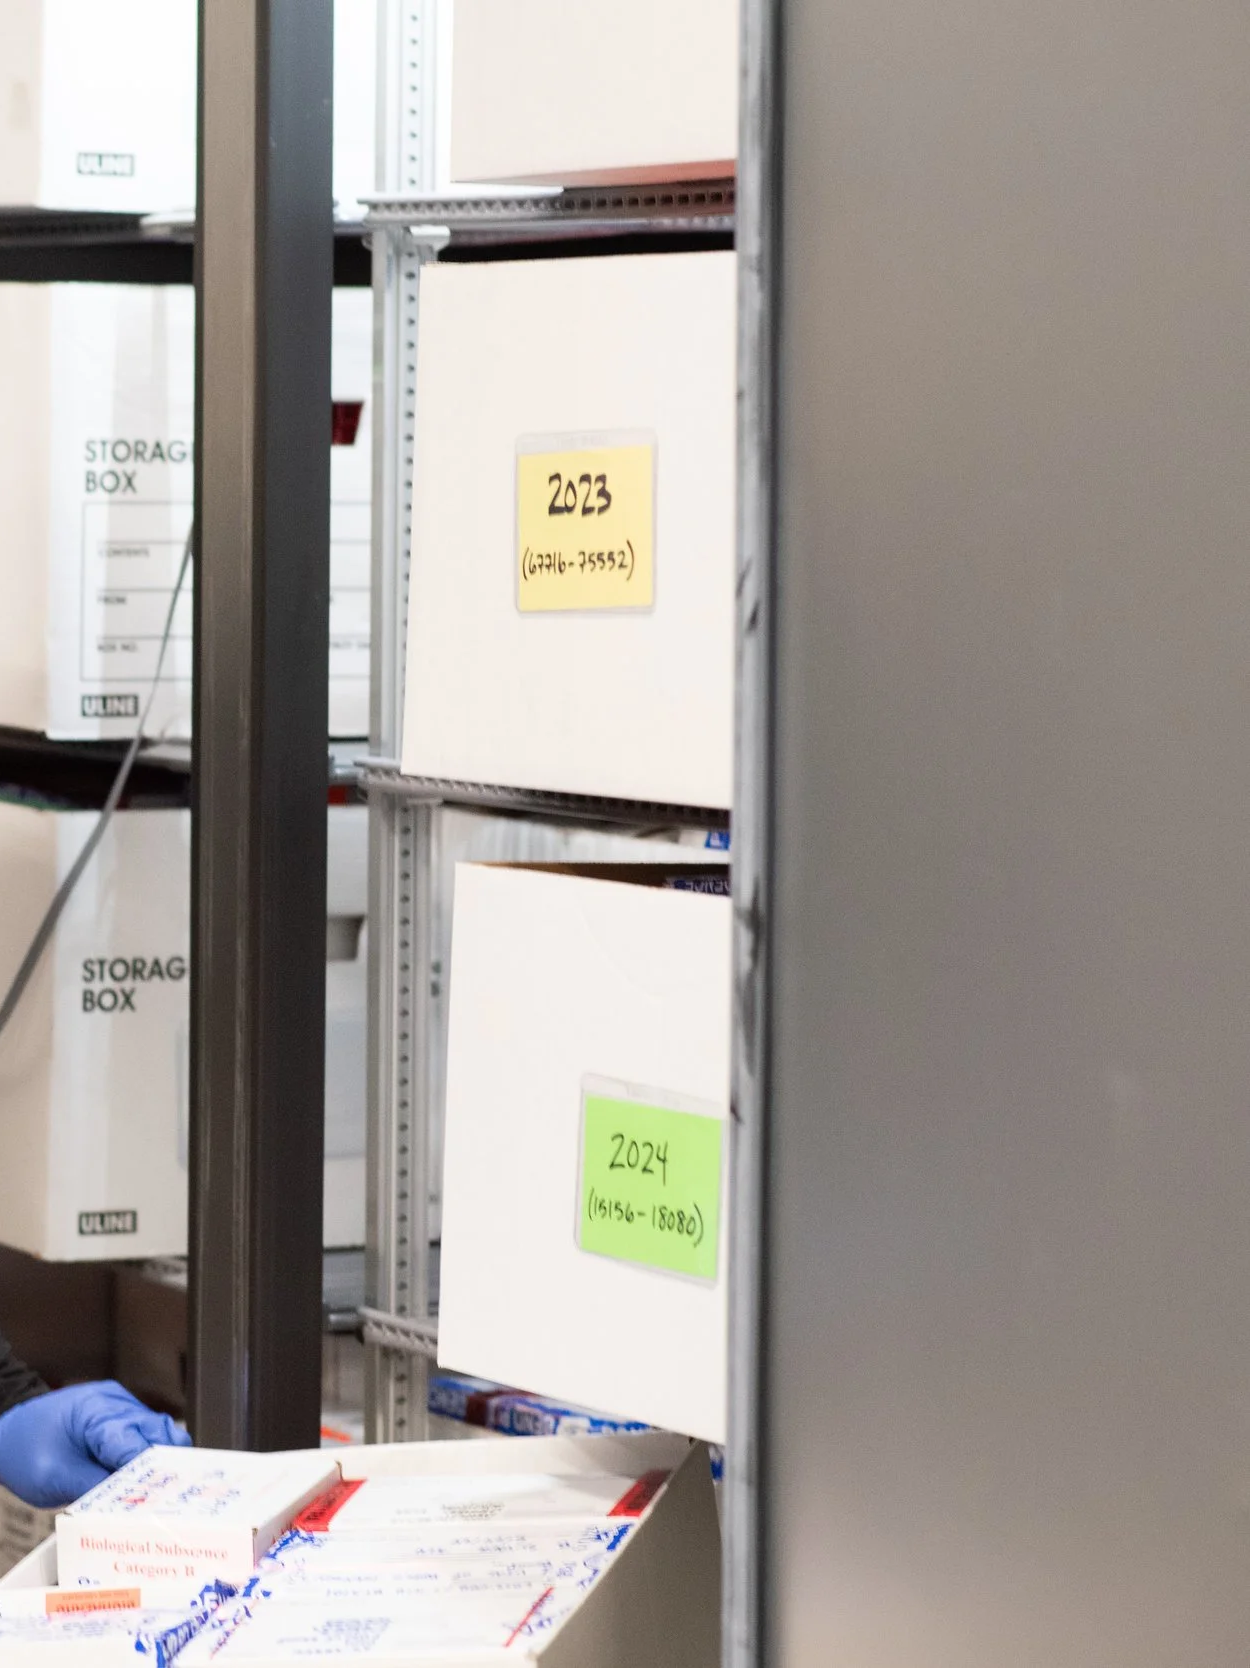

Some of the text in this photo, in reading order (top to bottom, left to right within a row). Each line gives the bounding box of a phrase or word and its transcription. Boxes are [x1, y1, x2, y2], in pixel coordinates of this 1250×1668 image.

[77, 152, 134, 177] ULINE
[85, 438, 188, 463] STORAG
[85, 468, 138, 494] BOX
[548, 472, 612, 517] 2023
[81, 694, 138, 717] ULINE
[82, 956, 186, 982] STORAG
[82, 987, 136, 1012] BOX
[609, 1132, 669, 1186] 2024
[78, 1209, 137, 1235] ULINE
[79, 1536, 150, 1555] Biological
[113, 1560, 178, 1577] Category
